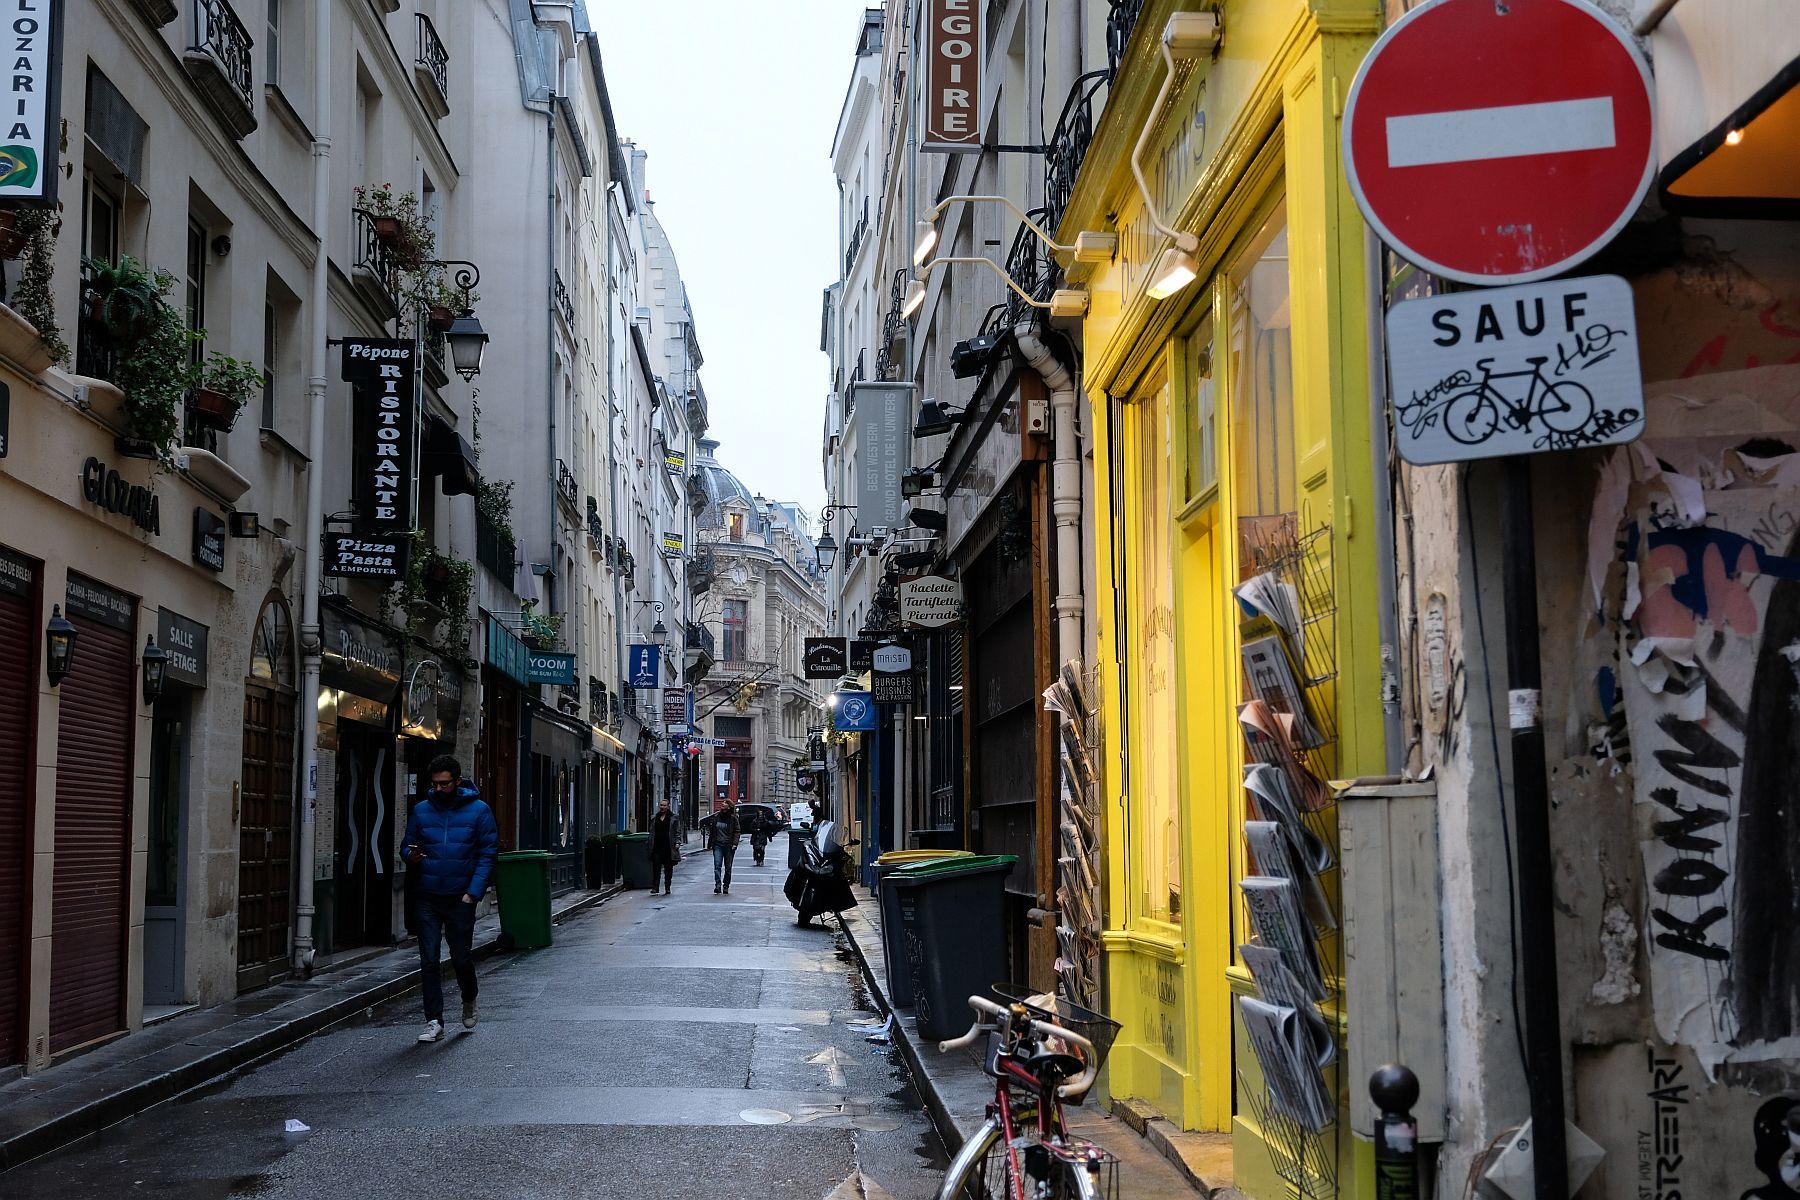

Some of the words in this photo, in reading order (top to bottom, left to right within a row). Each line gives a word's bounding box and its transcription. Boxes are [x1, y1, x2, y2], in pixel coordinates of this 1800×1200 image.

[1431, 291, 1588, 347] SAUF
[349, 344, 410, 360] Pépone
[884, 392, 897, 432] UNIVERS
[374, 364, 403, 519] RISTORANTE
[867, 423, 879, 466] WESTERN
[884, 444, 896, 456] DE
[867, 468, 879, 492] BEST
[884, 458, 896, 487] HOTEL
[884, 490, 896, 522] GRAND
[336, 538, 396, 553] Pizza
[337, 552, 393, 566] Pasta
[341, 565, 397, 575] EMPORTER
[908, 583, 955, 593] Raclette
[904, 596, 960, 608] Tartiflette
[907, 610, 958, 620] Pierrade
[170, 626, 193, 650] SALLE
[173, 651, 197, 674] ETAGE
[529, 658, 567, 670] YOOM
[810, 663, 842, 671] Citrouille
[875, 676, 912, 686] BURGERS
[664, 696, 685, 704] INDIEN
